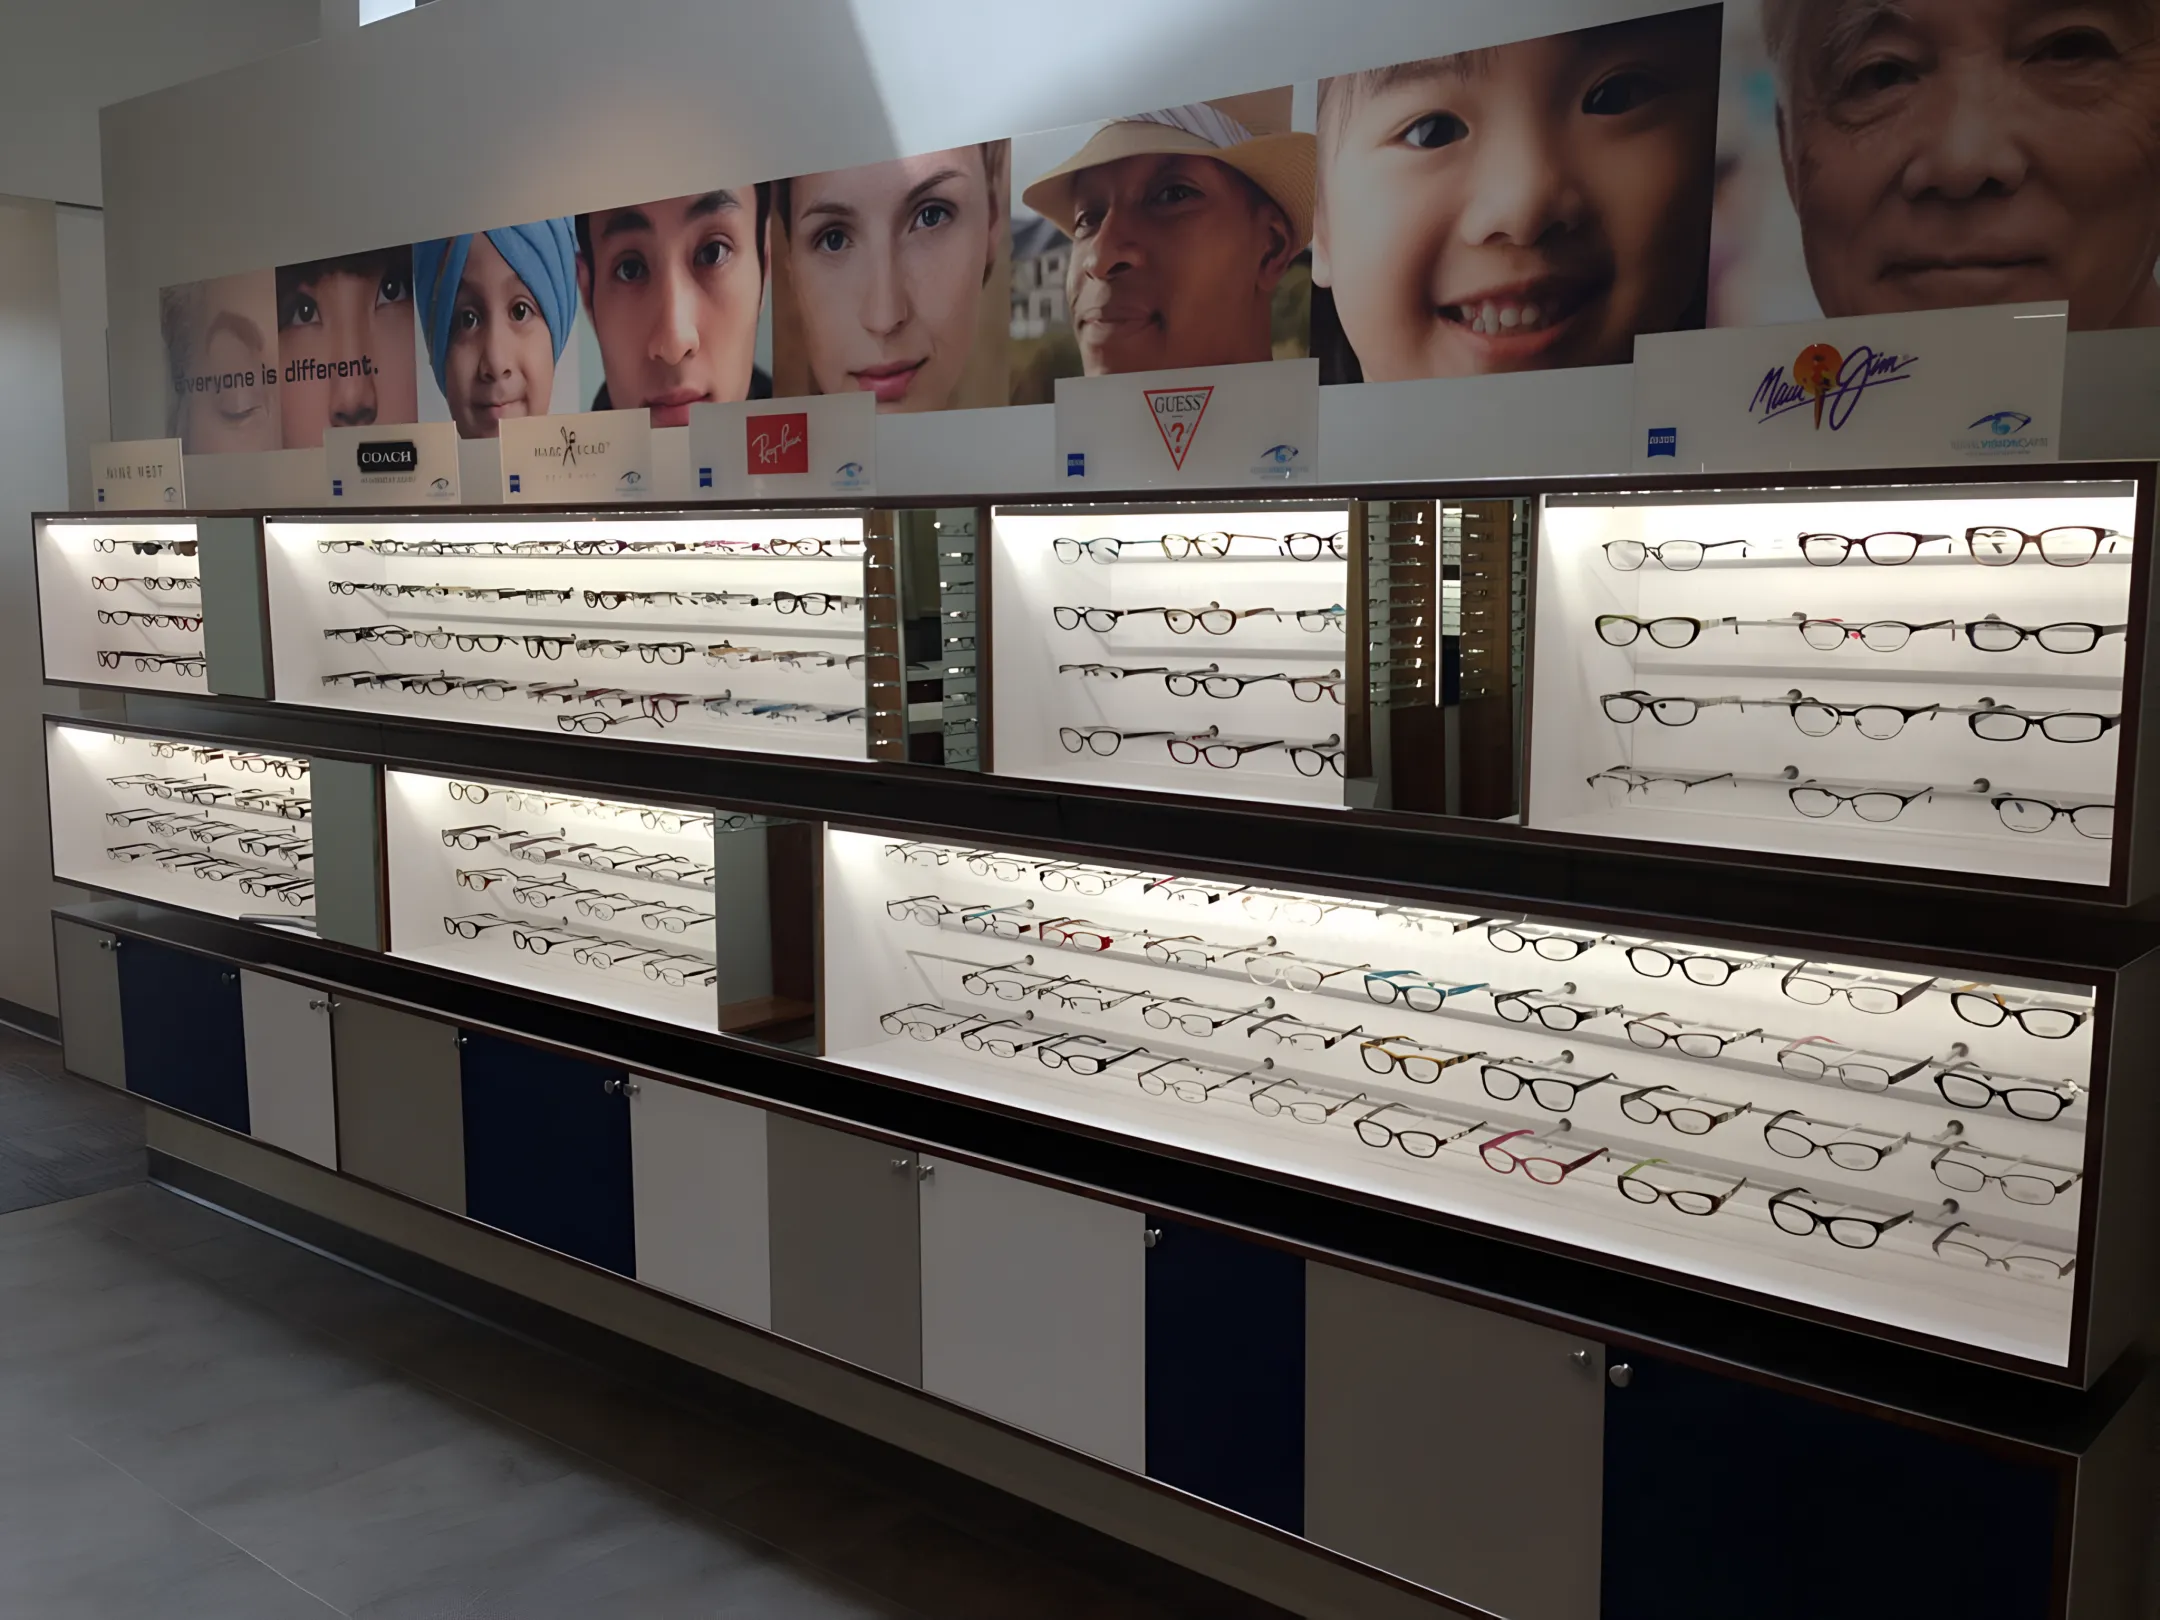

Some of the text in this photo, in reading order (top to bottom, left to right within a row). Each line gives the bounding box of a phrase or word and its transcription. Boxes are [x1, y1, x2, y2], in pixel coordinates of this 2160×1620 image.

[262, 363, 277, 385] is
[285, 355, 378, 382] different.
[1749, 345, 1918, 430] Maui Jim
[1155, 395, 1201, 413] GUESS
[361, 451, 412, 464] COACH
